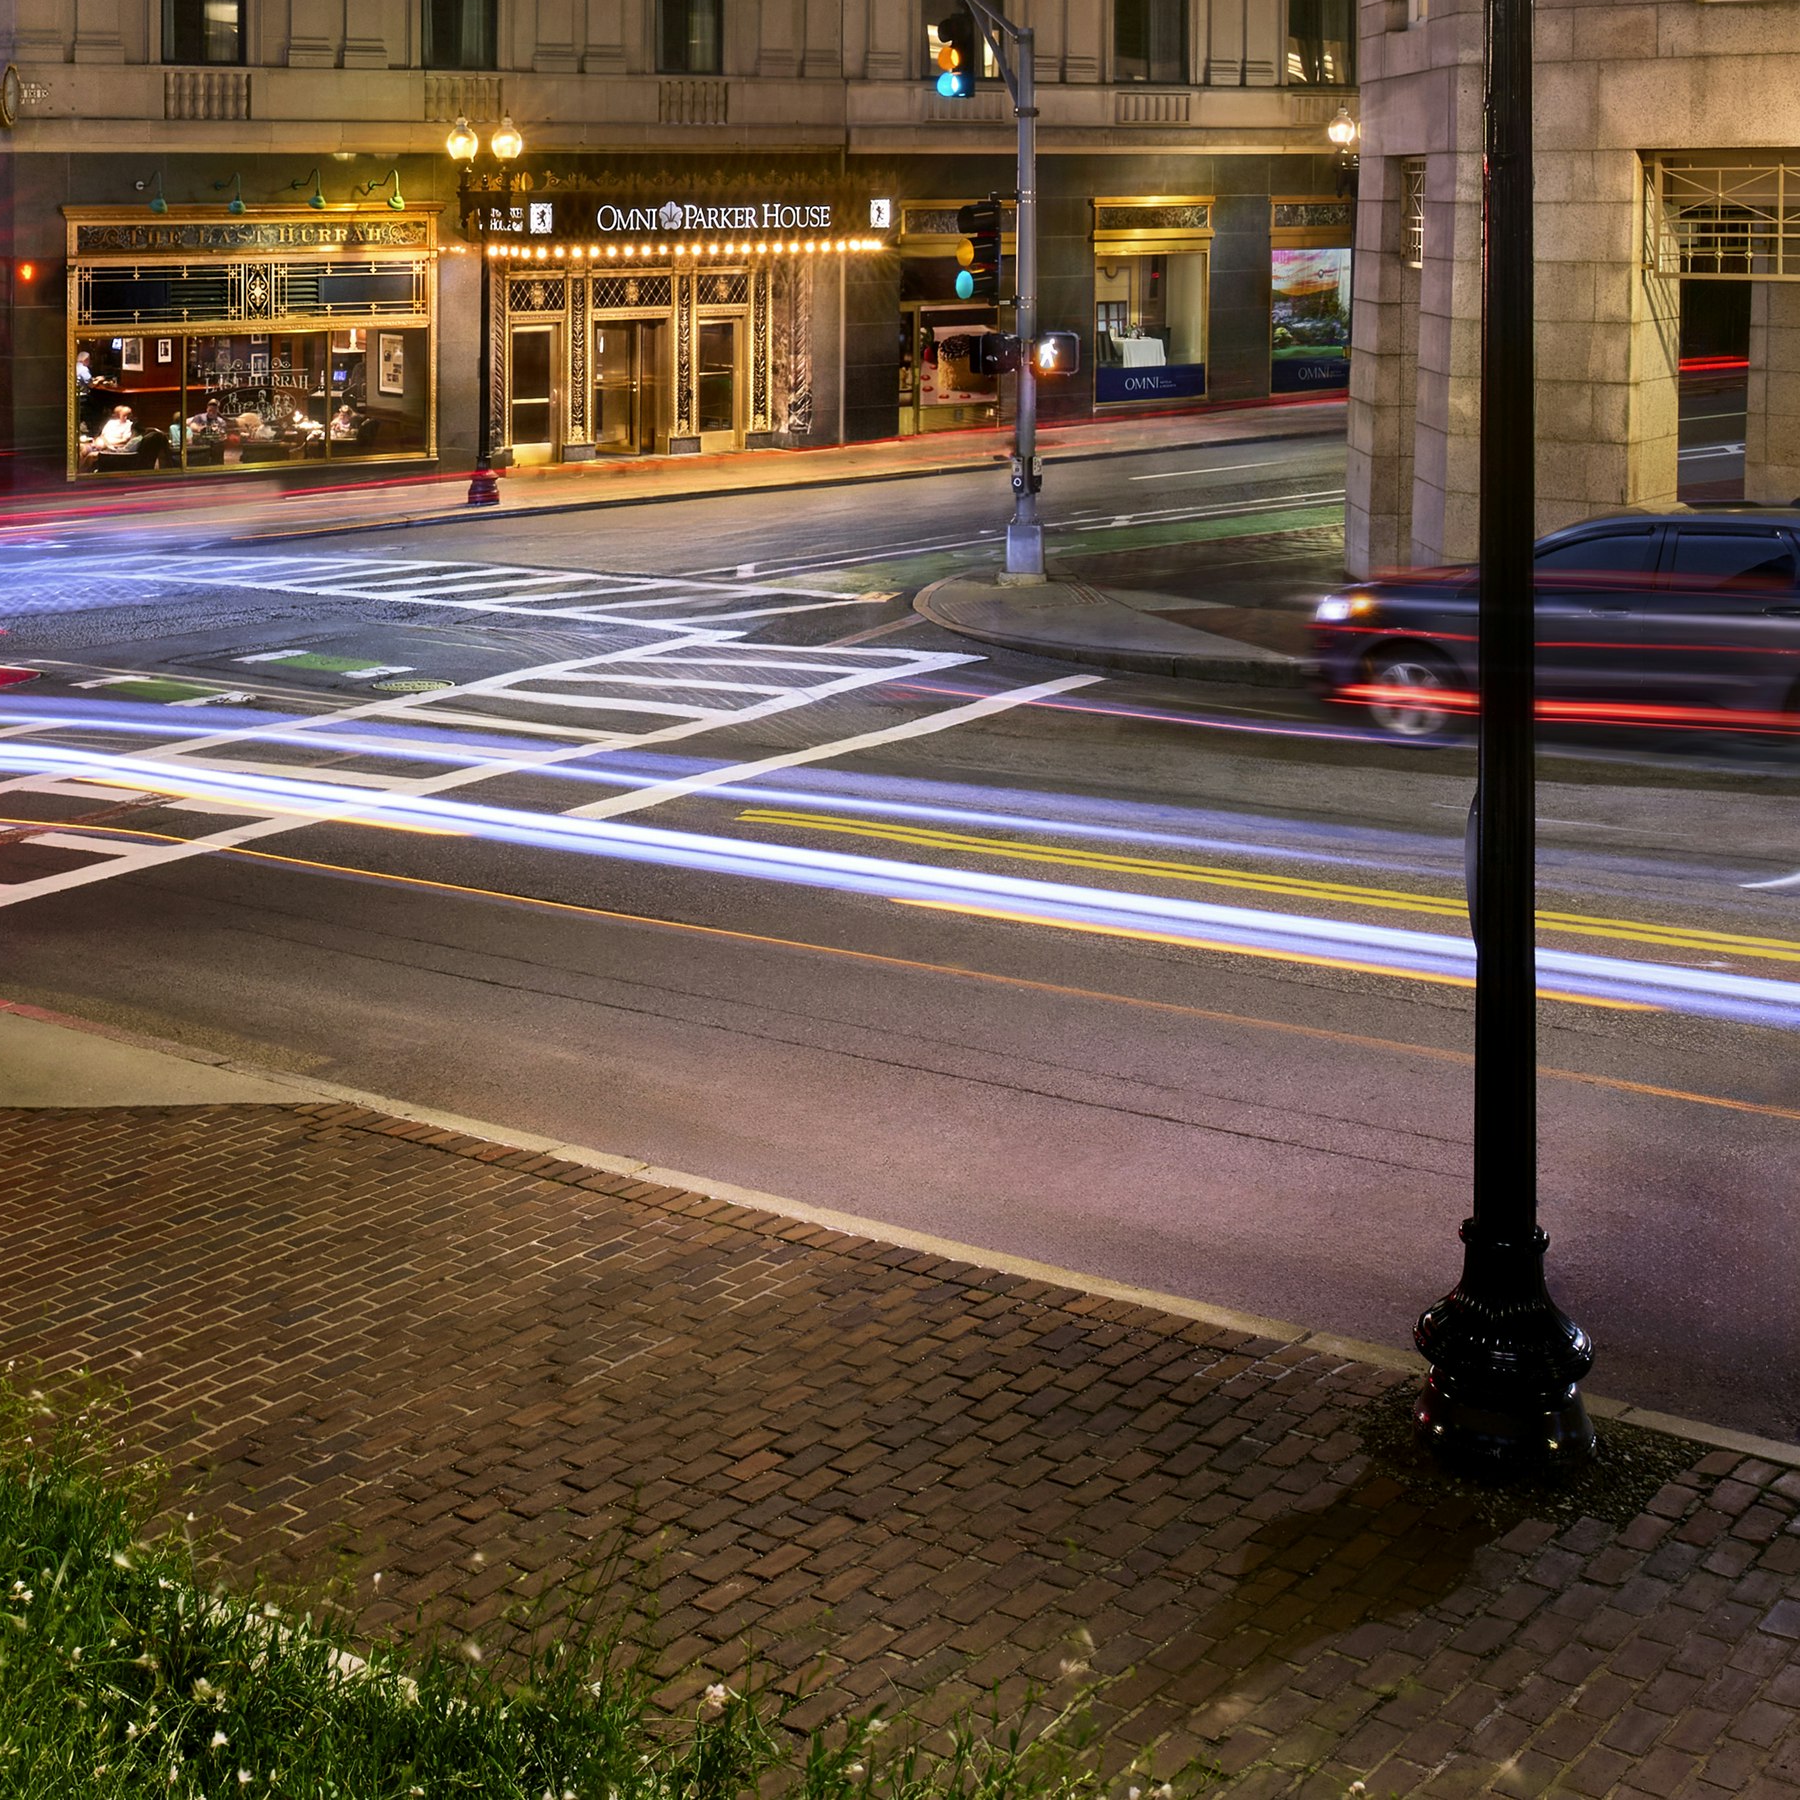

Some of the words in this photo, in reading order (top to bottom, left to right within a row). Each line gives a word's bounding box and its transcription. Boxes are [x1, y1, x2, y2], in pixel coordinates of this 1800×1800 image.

[597, 204, 658, 231] OMNI
[683, 204, 758, 229] PARKER
[762, 203, 831, 228] HOUSE
[128, 229, 183, 245] THE
[199, 229, 264, 244] LAST
[278, 227, 383, 243] HURRAH
[1298, 366, 1330, 380] OMNI
[248, 374, 309, 390] HURRAH
[1124, 376, 1159, 391] OMNI
